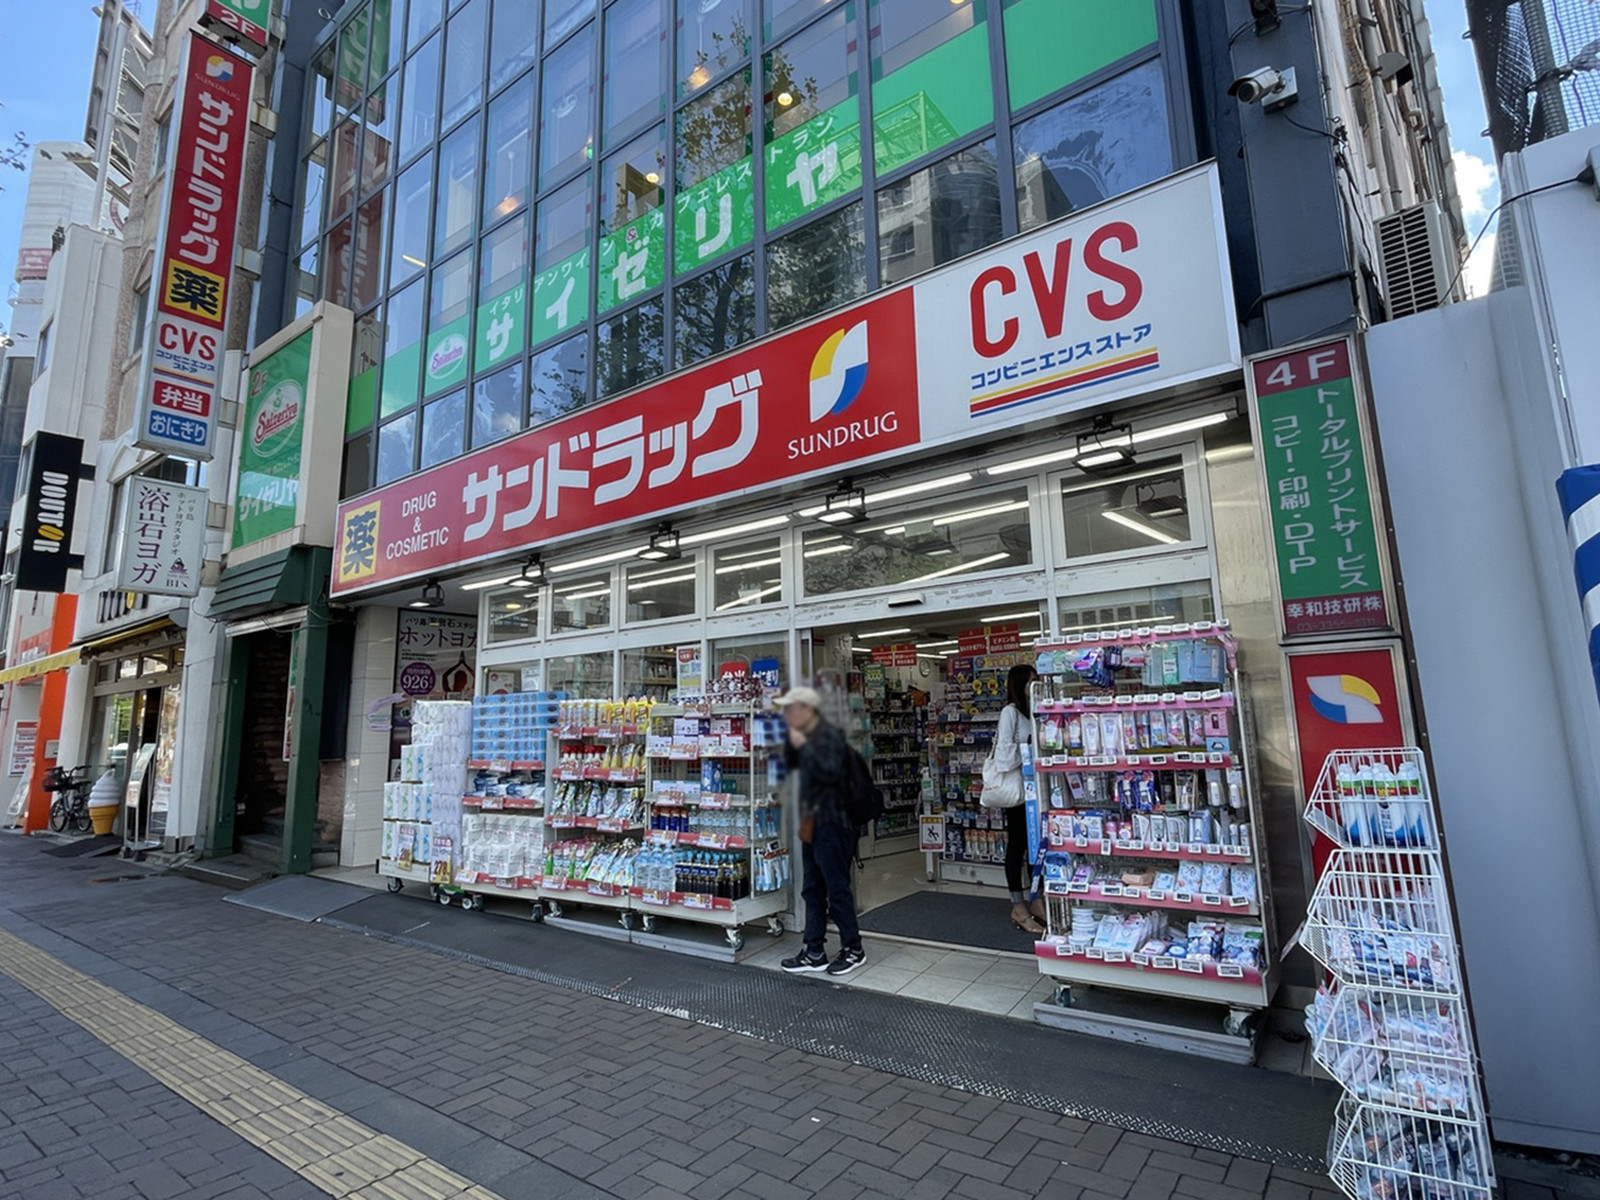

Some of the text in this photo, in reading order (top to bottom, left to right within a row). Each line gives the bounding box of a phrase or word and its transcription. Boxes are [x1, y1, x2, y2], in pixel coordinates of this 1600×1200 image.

[221, 9, 256, 34] 2F
[179, 91, 234, 265] サンドラッグ
[486, 141, 838, 362] サイゼリヤ
[169, 266, 220, 316] 薬
[969, 221, 1143, 359] CVS
[156, 349, 215, 372] コンビニエンス
[159, 323, 216, 361] CVS
[971, 323, 1152, 390] コンビニエンスストア
[173, 362, 198, 373] ストア
[161, 386, 203, 413] 弁当
[151, 414, 206, 443] おにぎり
[786, 411, 899, 461] SUNDRUG
[462, 369, 764, 543] サンドラッグ
[402, 490, 437, 518] DRUG
[1317, 388, 1369, 589] トータルプリントサービス
[342, 510, 377, 576] 薬
[386, 526, 450, 560] COSMETIC
[413, 516, 422, 534] &
[402, 674, 429, 689] 926
